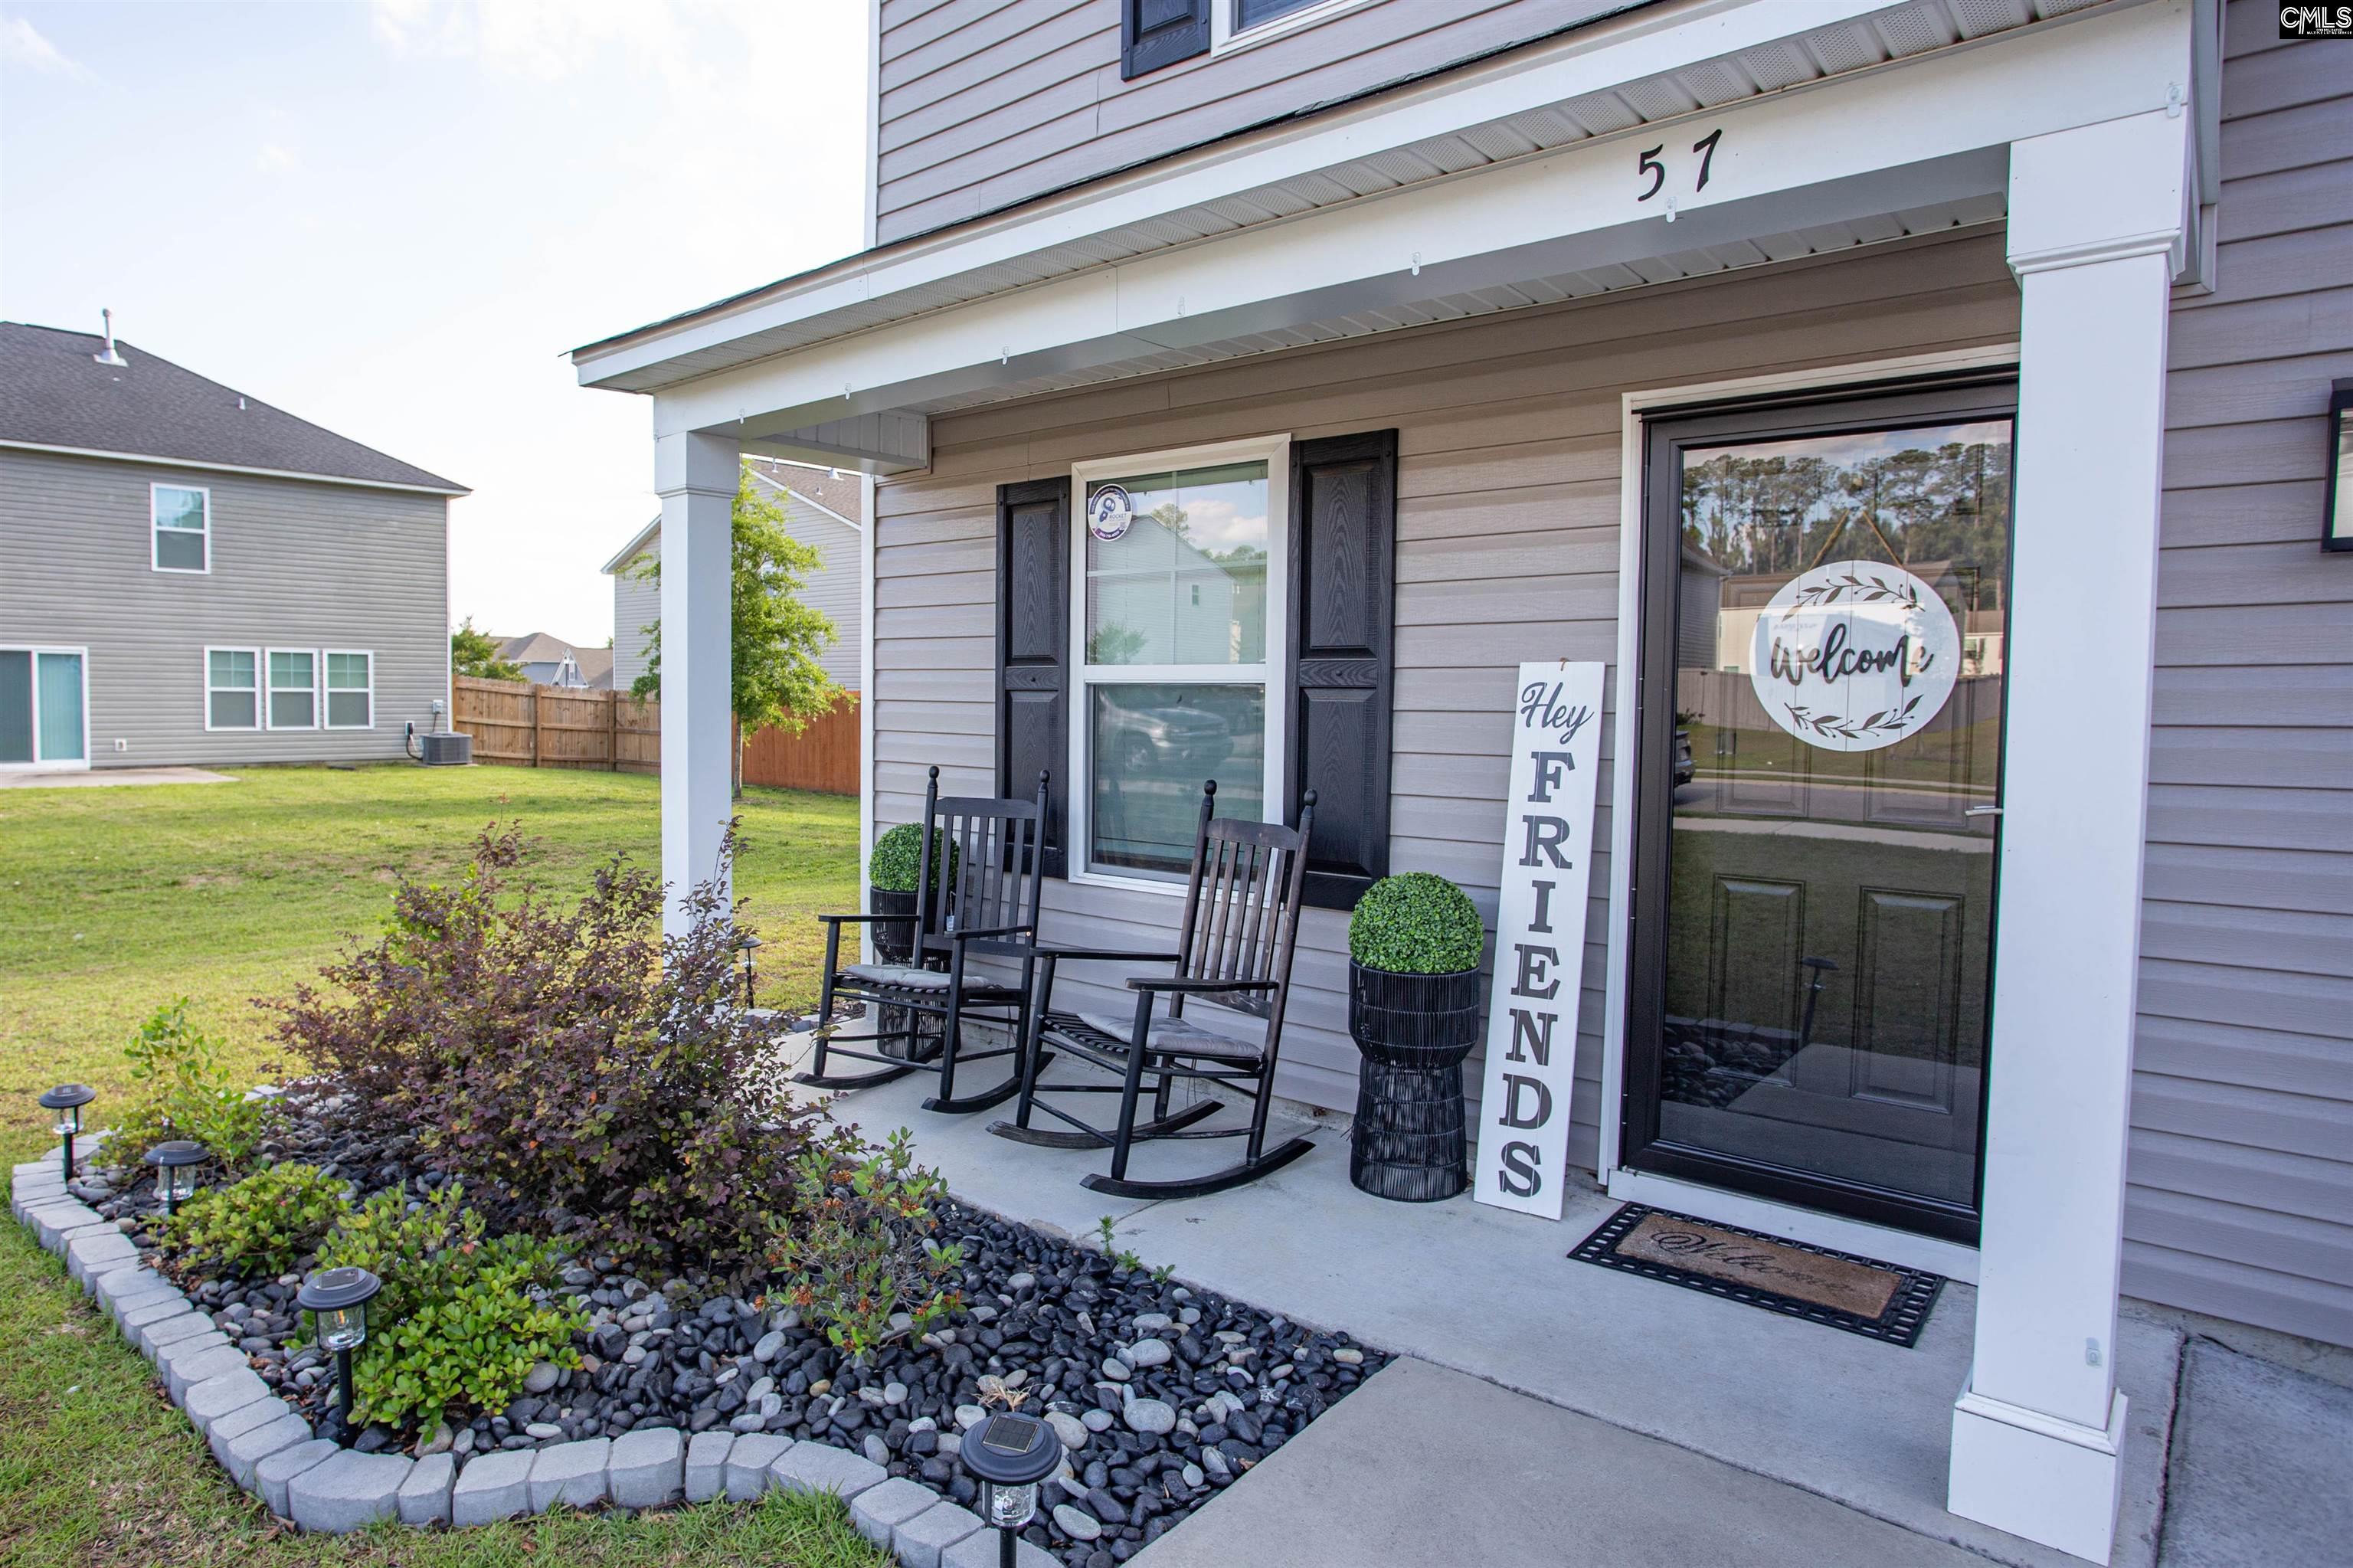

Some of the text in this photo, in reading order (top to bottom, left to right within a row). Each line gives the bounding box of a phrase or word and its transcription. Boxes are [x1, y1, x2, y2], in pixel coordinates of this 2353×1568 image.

[1638, 129, 1722, 201] 57
[1520, 682, 1595, 745] Hey
[1498, 751, 1576, 1198] FRIENDS
